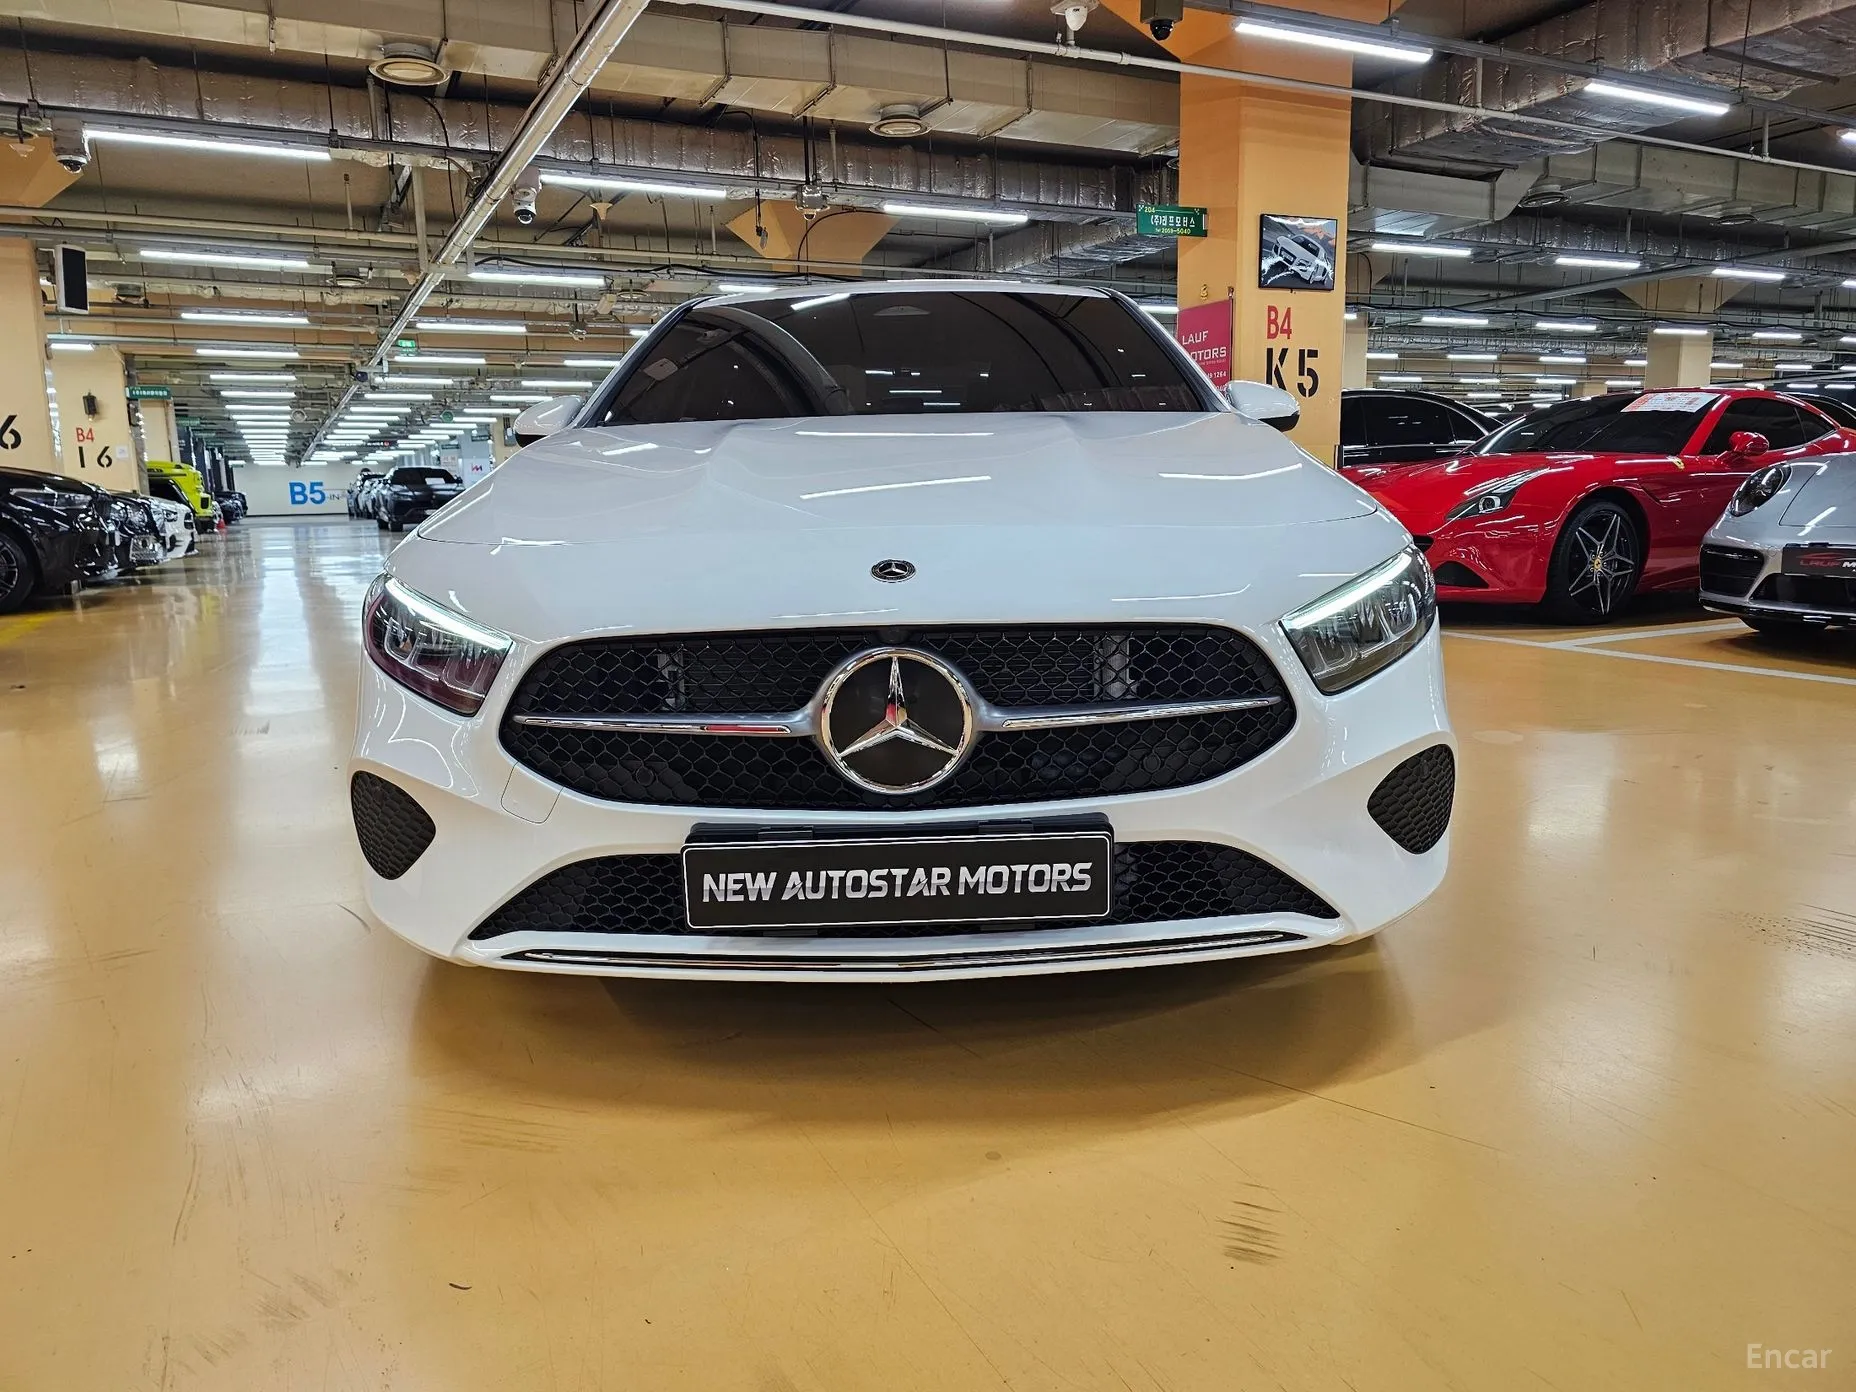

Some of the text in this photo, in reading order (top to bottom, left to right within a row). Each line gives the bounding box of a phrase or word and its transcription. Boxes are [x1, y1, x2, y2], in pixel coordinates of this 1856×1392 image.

[1266, 305, 1292, 340] B4
[1182, 330, 1209, 346] LAUF
[1189, 346, 1227, 361] OTORS
[0, 414, 22, 450] 6
[75, 427, 95, 443] B4
[289, 481, 326, 505] B5
[702, 862, 1093, 902] NEW AUTOSTAR MOTORS
